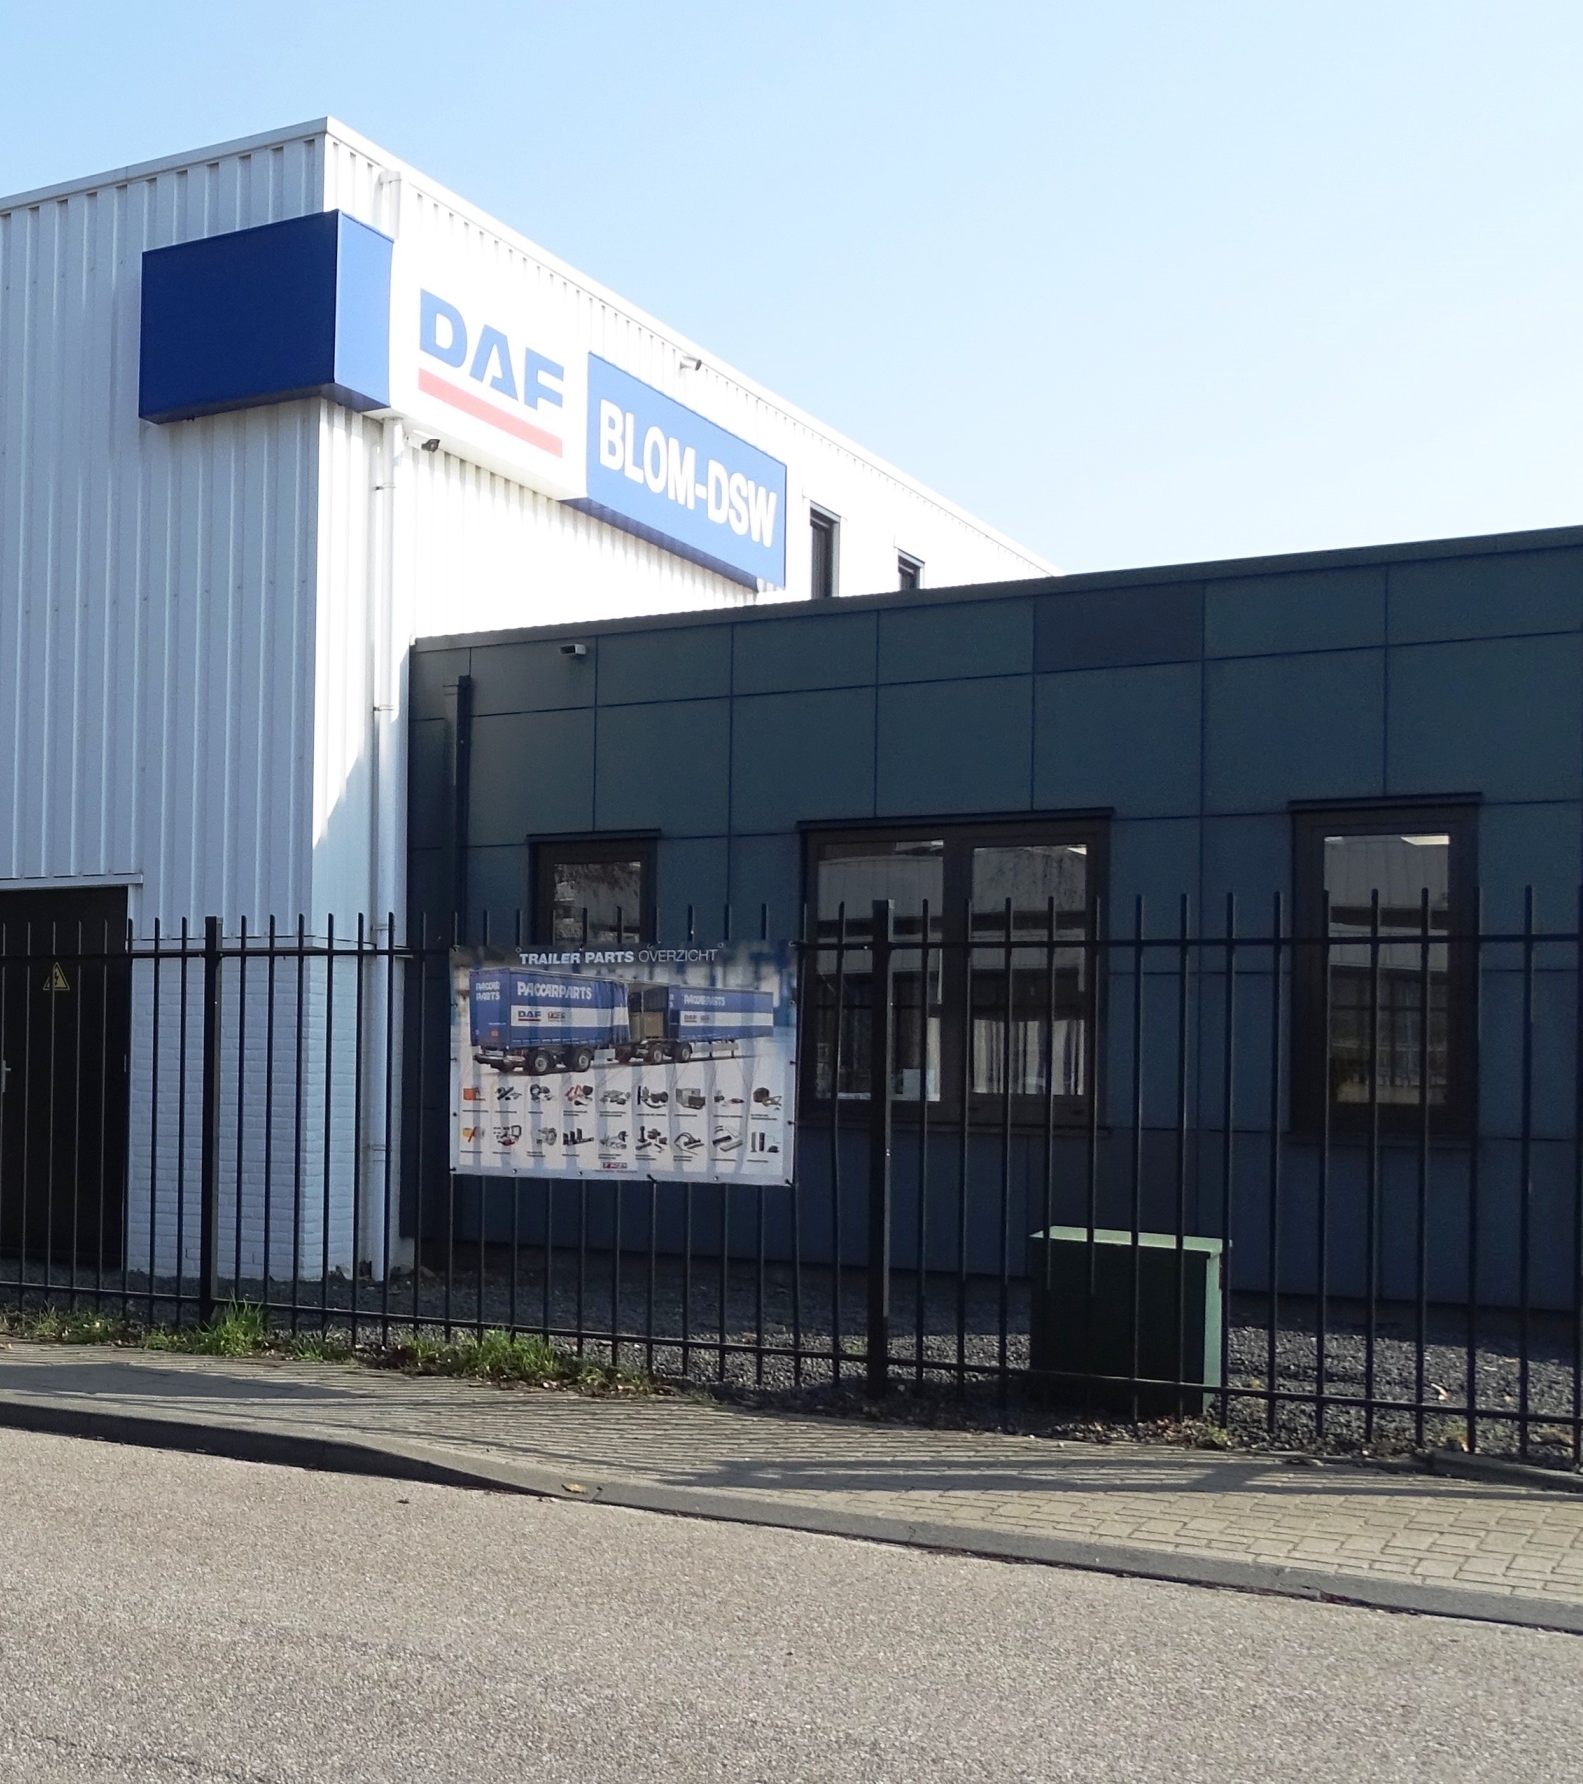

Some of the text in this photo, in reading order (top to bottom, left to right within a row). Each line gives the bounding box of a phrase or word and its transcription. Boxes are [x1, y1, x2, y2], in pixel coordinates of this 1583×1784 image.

[419, 288, 564, 409] DAF
[599, 398, 777, 548] BLOM-DSW
[519, 949, 718, 965] TRAILER PARTS OVERZICHT
[518, 1010, 541, 1019] DAF
